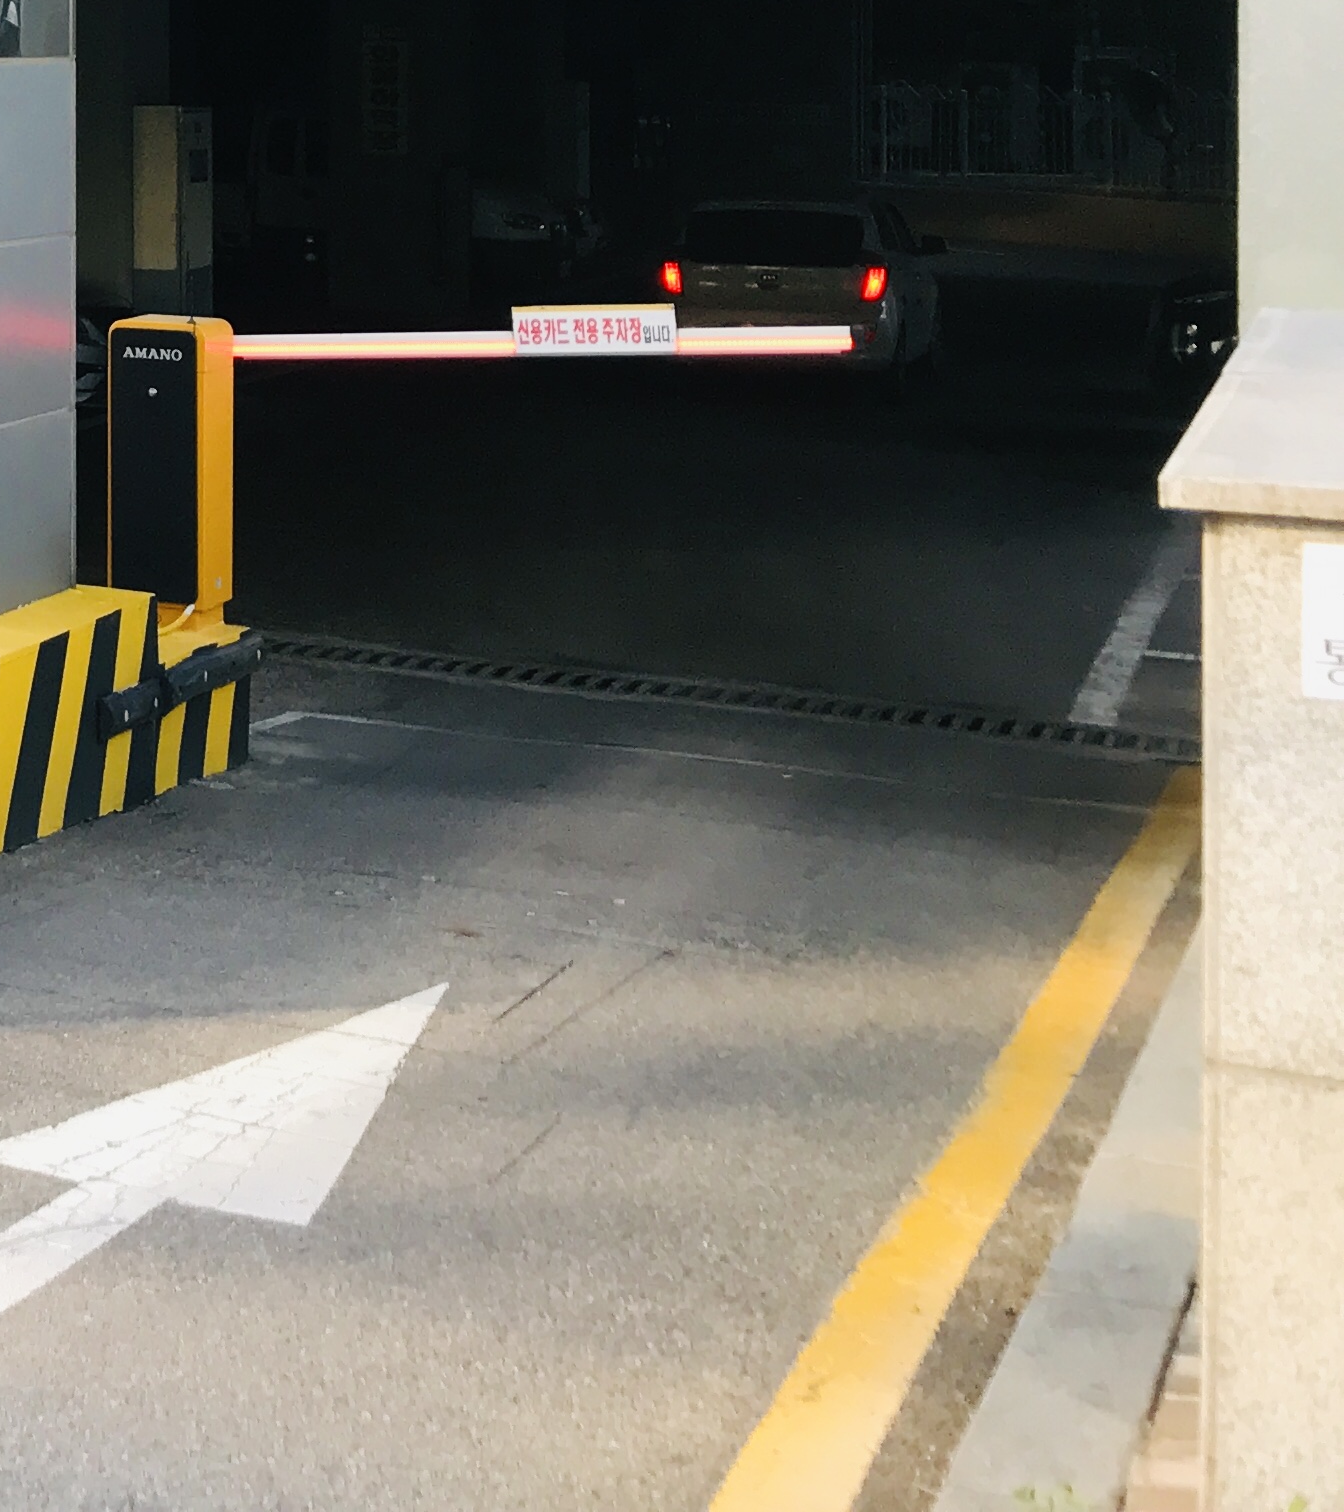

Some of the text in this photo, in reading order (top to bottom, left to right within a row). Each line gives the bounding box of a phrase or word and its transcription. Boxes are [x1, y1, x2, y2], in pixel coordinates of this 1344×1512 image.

[517, 318, 570, 345] 신용카드
[573, 317, 599, 345] 전용
[123, 346, 183, 363] AMANO
